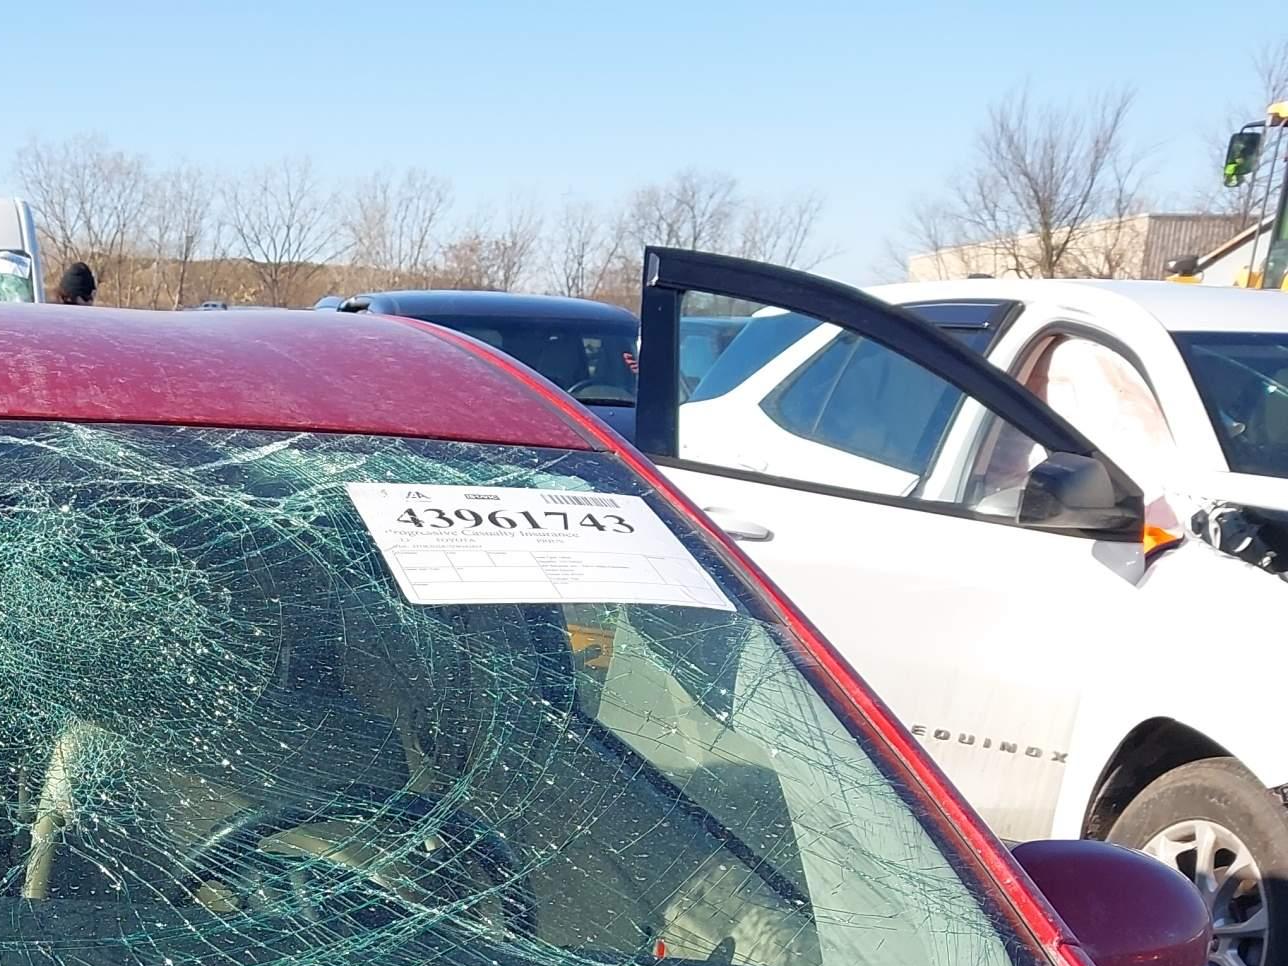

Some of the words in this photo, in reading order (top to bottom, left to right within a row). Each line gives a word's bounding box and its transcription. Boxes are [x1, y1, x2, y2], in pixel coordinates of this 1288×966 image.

[396, 507, 635, 534] 43961743
[461, 529, 515, 537] Casualty
[519, 530, 580, 538] Insurance
[910, 724, 1069, 764] EQUINOX
